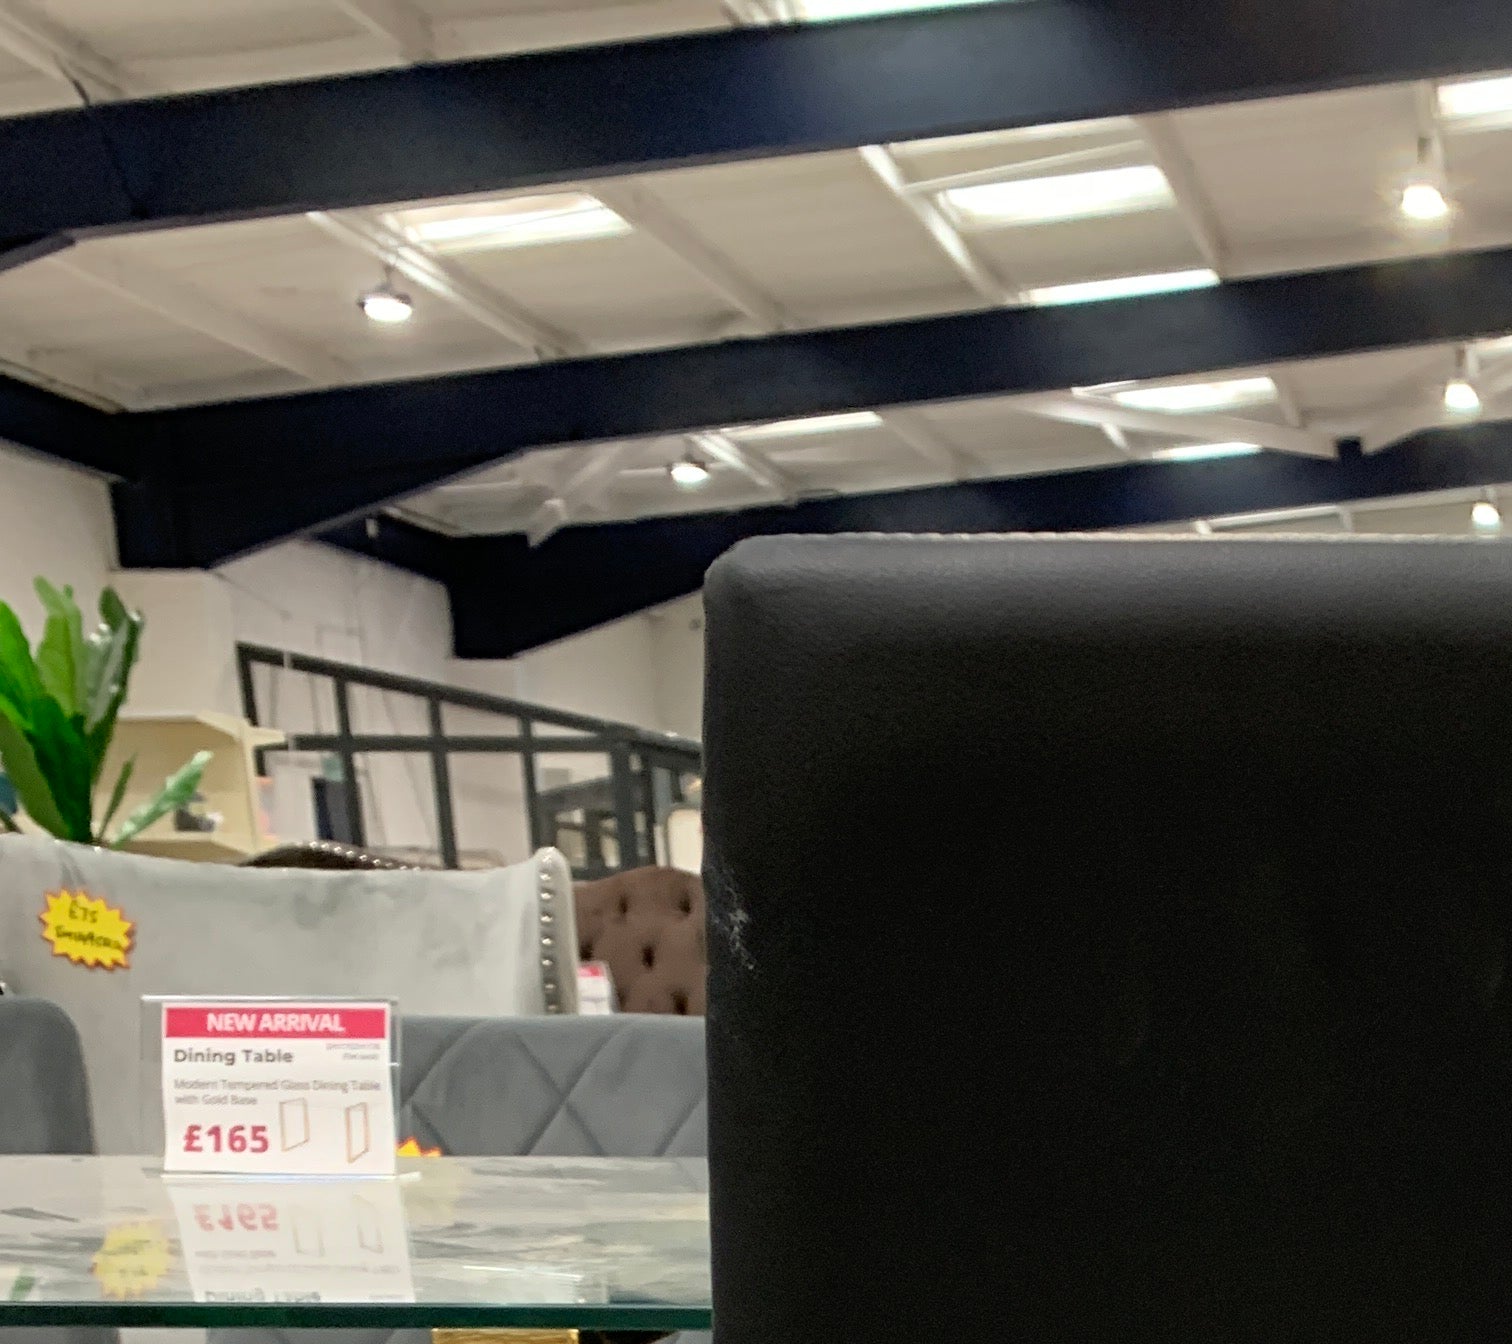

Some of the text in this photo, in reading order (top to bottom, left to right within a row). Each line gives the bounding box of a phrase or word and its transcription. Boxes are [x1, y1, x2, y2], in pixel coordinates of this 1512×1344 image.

[206, 1012, 346, 1033] NEW ARRIVAL
[174, 1047, 294, 1066] Dining Table
[174, 1079, 218, 1089] Modern
[220, 1079, 279, 1091] Tempered
[312, 1079, 349, 1094] Dining
[350, 1080, 381, 1091] Table
[183, 1124, 270, 1153] £165
